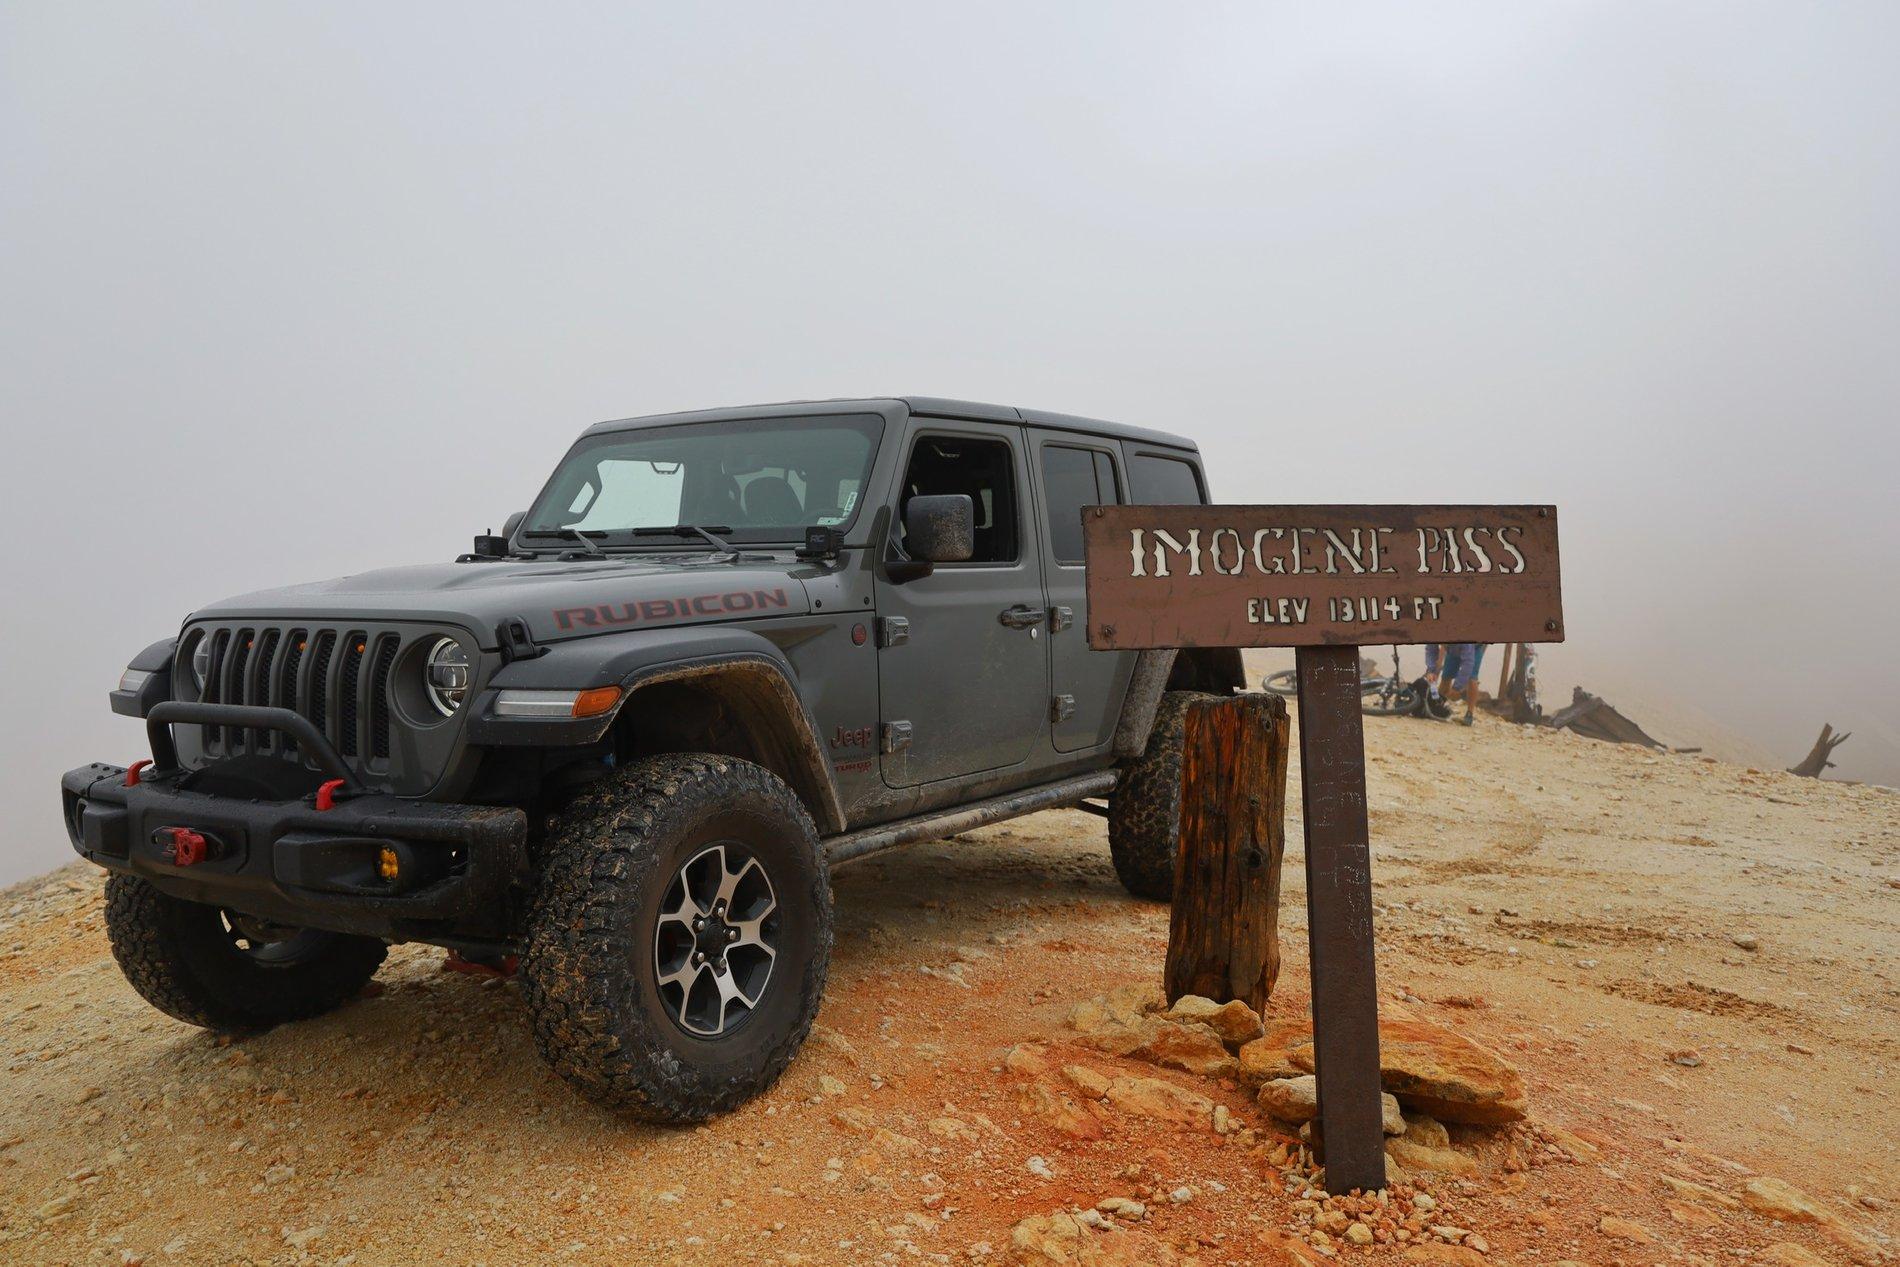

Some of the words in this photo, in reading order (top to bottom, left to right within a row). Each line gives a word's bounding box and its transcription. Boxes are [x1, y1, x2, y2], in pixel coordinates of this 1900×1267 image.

[1129, 526, 1398, 578] IMOGENE
[1415, 525, 1526, 576] PASS
[551, 587, 789, 631] RUBICON
[1247, 597, 1310, 624] ELEV
[1329, 596, 1401, 623] 13114
[1413, 596, 1444, 622] FT
[830, 725, 873, 750] Jeep
